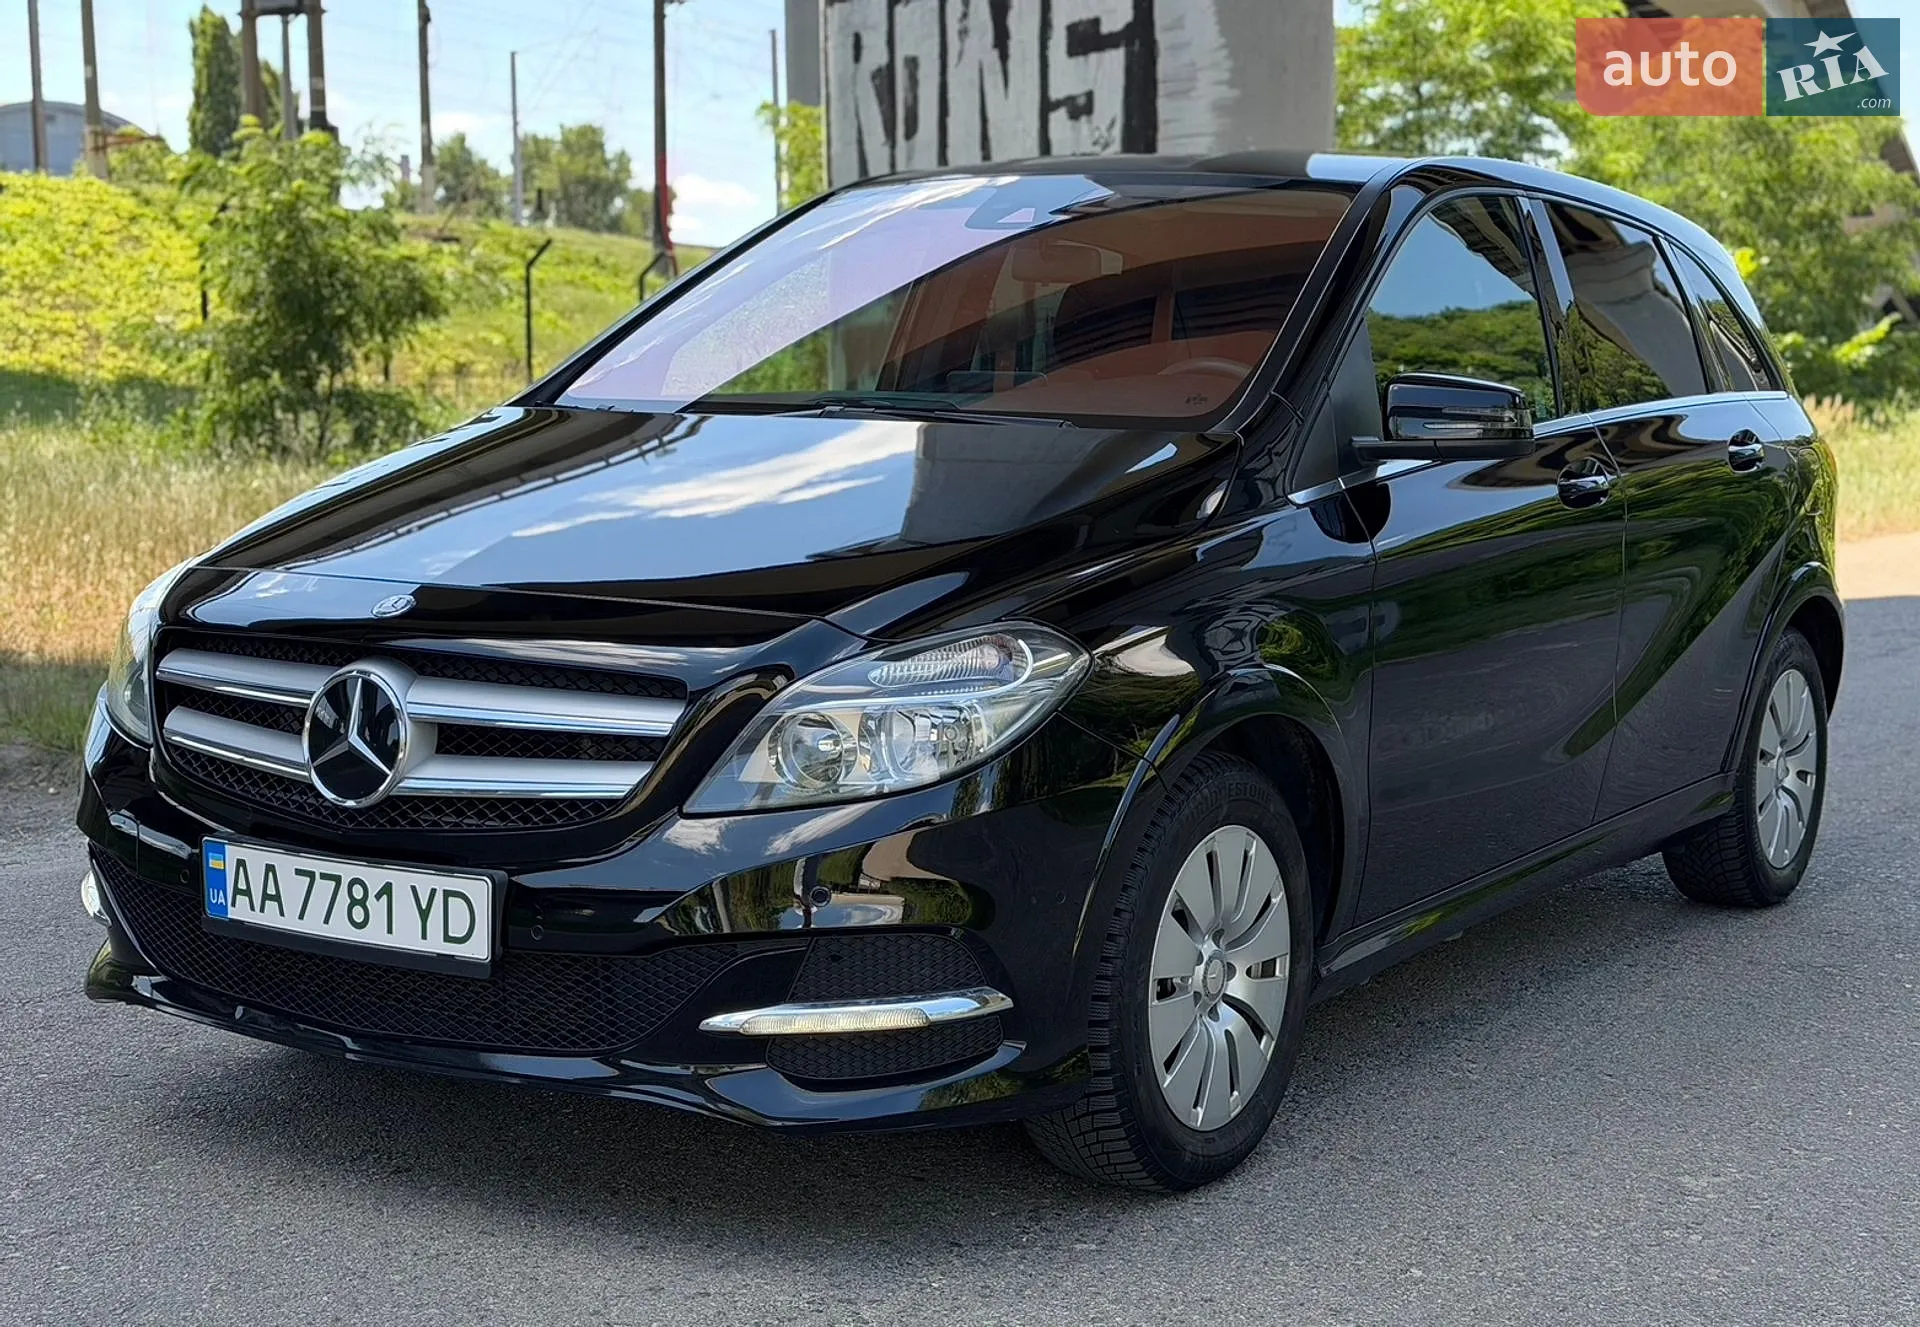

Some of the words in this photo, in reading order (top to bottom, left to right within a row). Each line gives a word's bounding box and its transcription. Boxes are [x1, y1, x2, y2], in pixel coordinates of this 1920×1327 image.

[209, 887, 226, 907] UA
[230, 858, 286, 918] AA
[294, 867, 394, 936] 7781
[410, 884, 477, 946] YD
